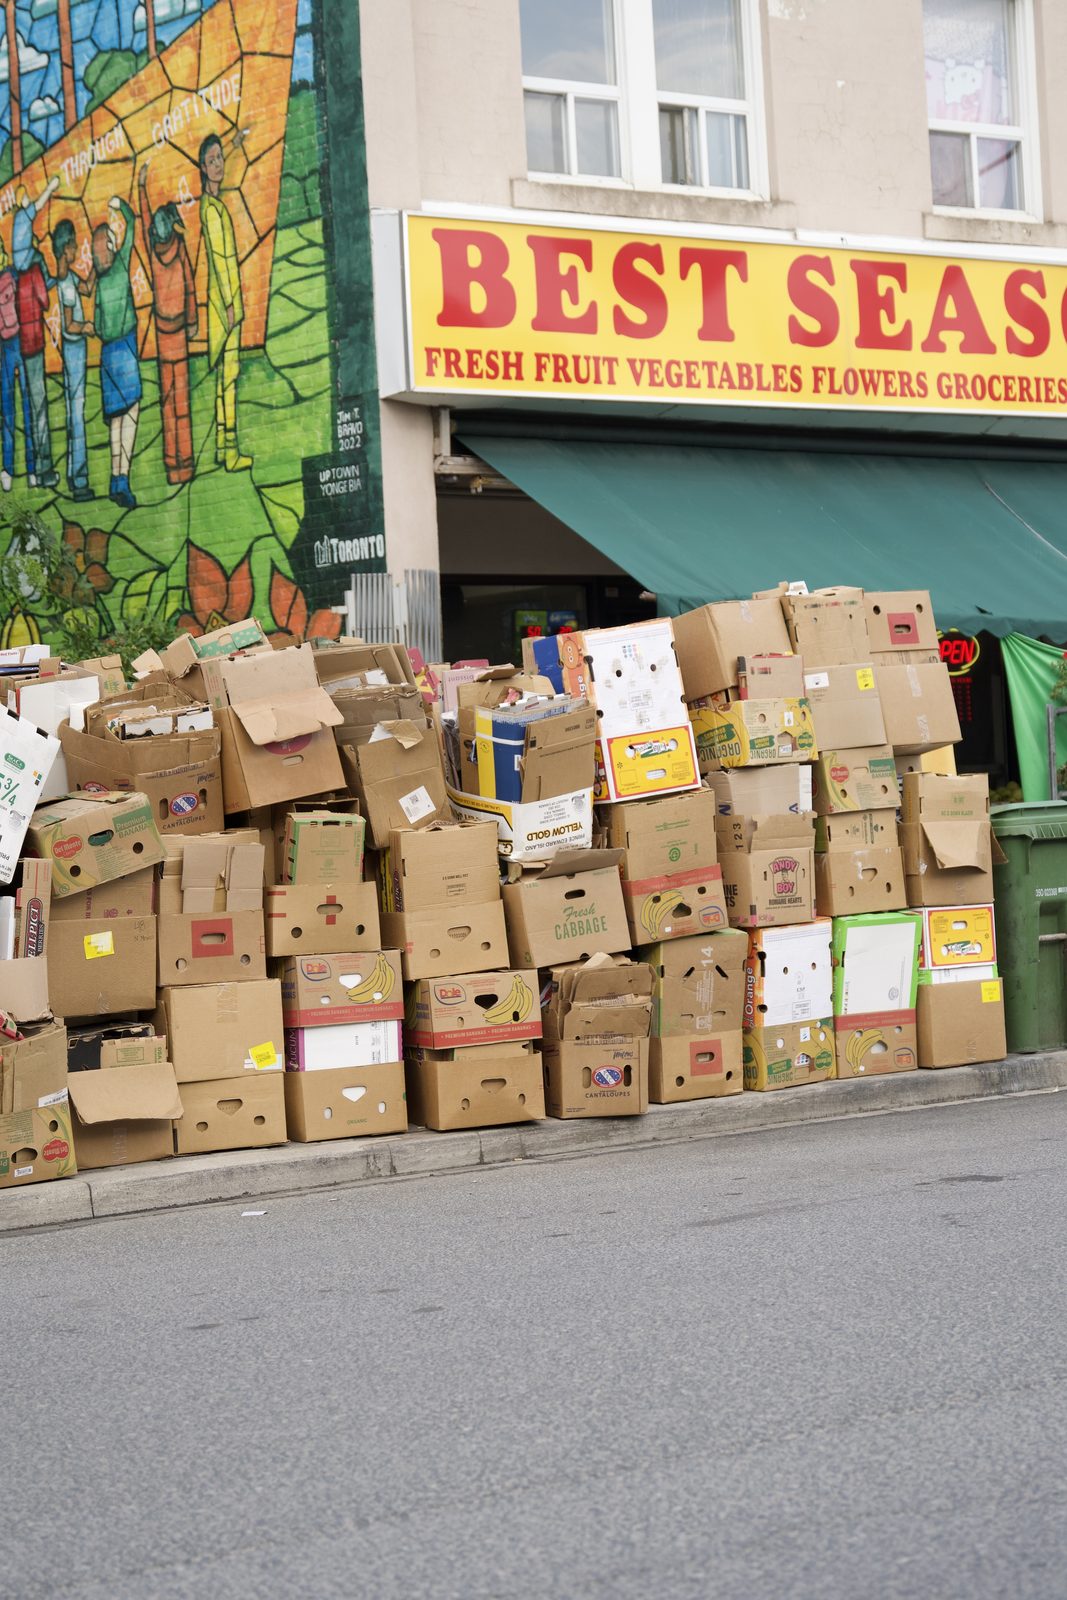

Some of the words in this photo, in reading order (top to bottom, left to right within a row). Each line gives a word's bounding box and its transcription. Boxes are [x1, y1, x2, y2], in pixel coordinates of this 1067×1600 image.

[60, 124, 125, 187] THROUGH
[152, 74, 241, 149] GRATITUDE
[432, 229, 747, 341] BEST
[788, 256, 1067, 357] SEAS
[425, 348, 523, 380] FRESH
[535, 353, 617, 384] FRUIT
[628, 359, 802, 392] VEGETABLES
[813, 367, 927, 397] FLOWERS
[937, 374, 1067, 403] GROCERIES
[337, 421, 363, 438] BRAVO
[339, 436, 361, 451] 2022
[319, 465, 360, 483] UPTOWN
[320, 482, 348, 497] YONGE
[348, 478, 362, 492] BIA
[330, 534, 385, 564] TORONTO
[750, 748, 776, 759] ORGANIC
[117, 816, 147, 829] Premium
[162, 815, 206, 830] CANTALOUPES
[551, 822, 583, 837] YELLOW
[733, 822, 741, 830] 3
[526, 830, 550, 842] GOLD
[545, 838, 567, 847] EDWARD
[54, 844, 65, 854] Del
[64, 841, 81, 852] Monte
[524, 842, 544, 851] ISLAND
[771, 859, 798, 874] ANDY
[776, 882, 795, 894] BOY
[563, 903, 596, 921] Fresh
[27, 904, 40, 958] ELLPICT
[554, 916, 608, 940] CABBAGE
[701, 946, 714, 967] 14
[439, 988, 461, 998] Dole
[745, 967, 756, 1015] Orange
[585, 1091, 631, 1099] CANTALOUPES
